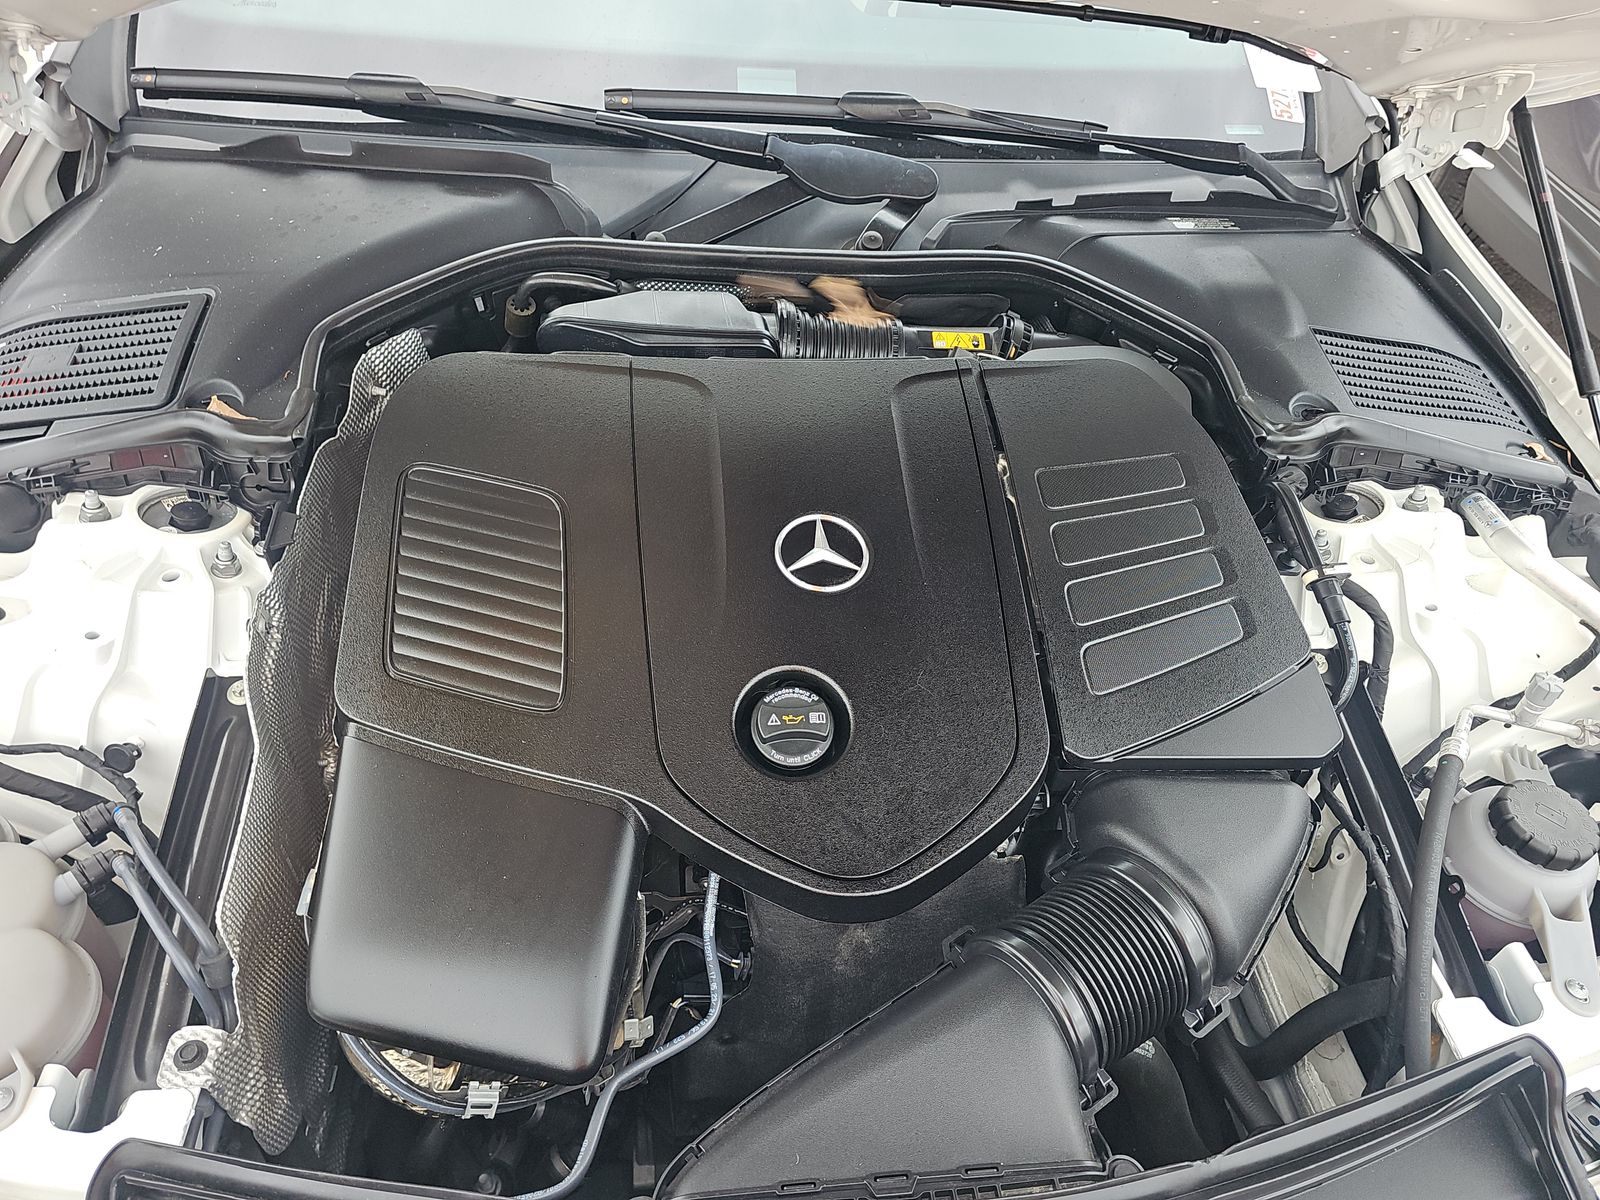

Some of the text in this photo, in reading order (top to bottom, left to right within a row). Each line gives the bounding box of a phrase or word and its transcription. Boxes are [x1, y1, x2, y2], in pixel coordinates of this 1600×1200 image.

[764, 688, 810, 702] Mercedes-Benz
[772, 693, 812, 704] recommended
[770, 749, 785, 761] Turn
[803, 748, 822, 761] CLICK
